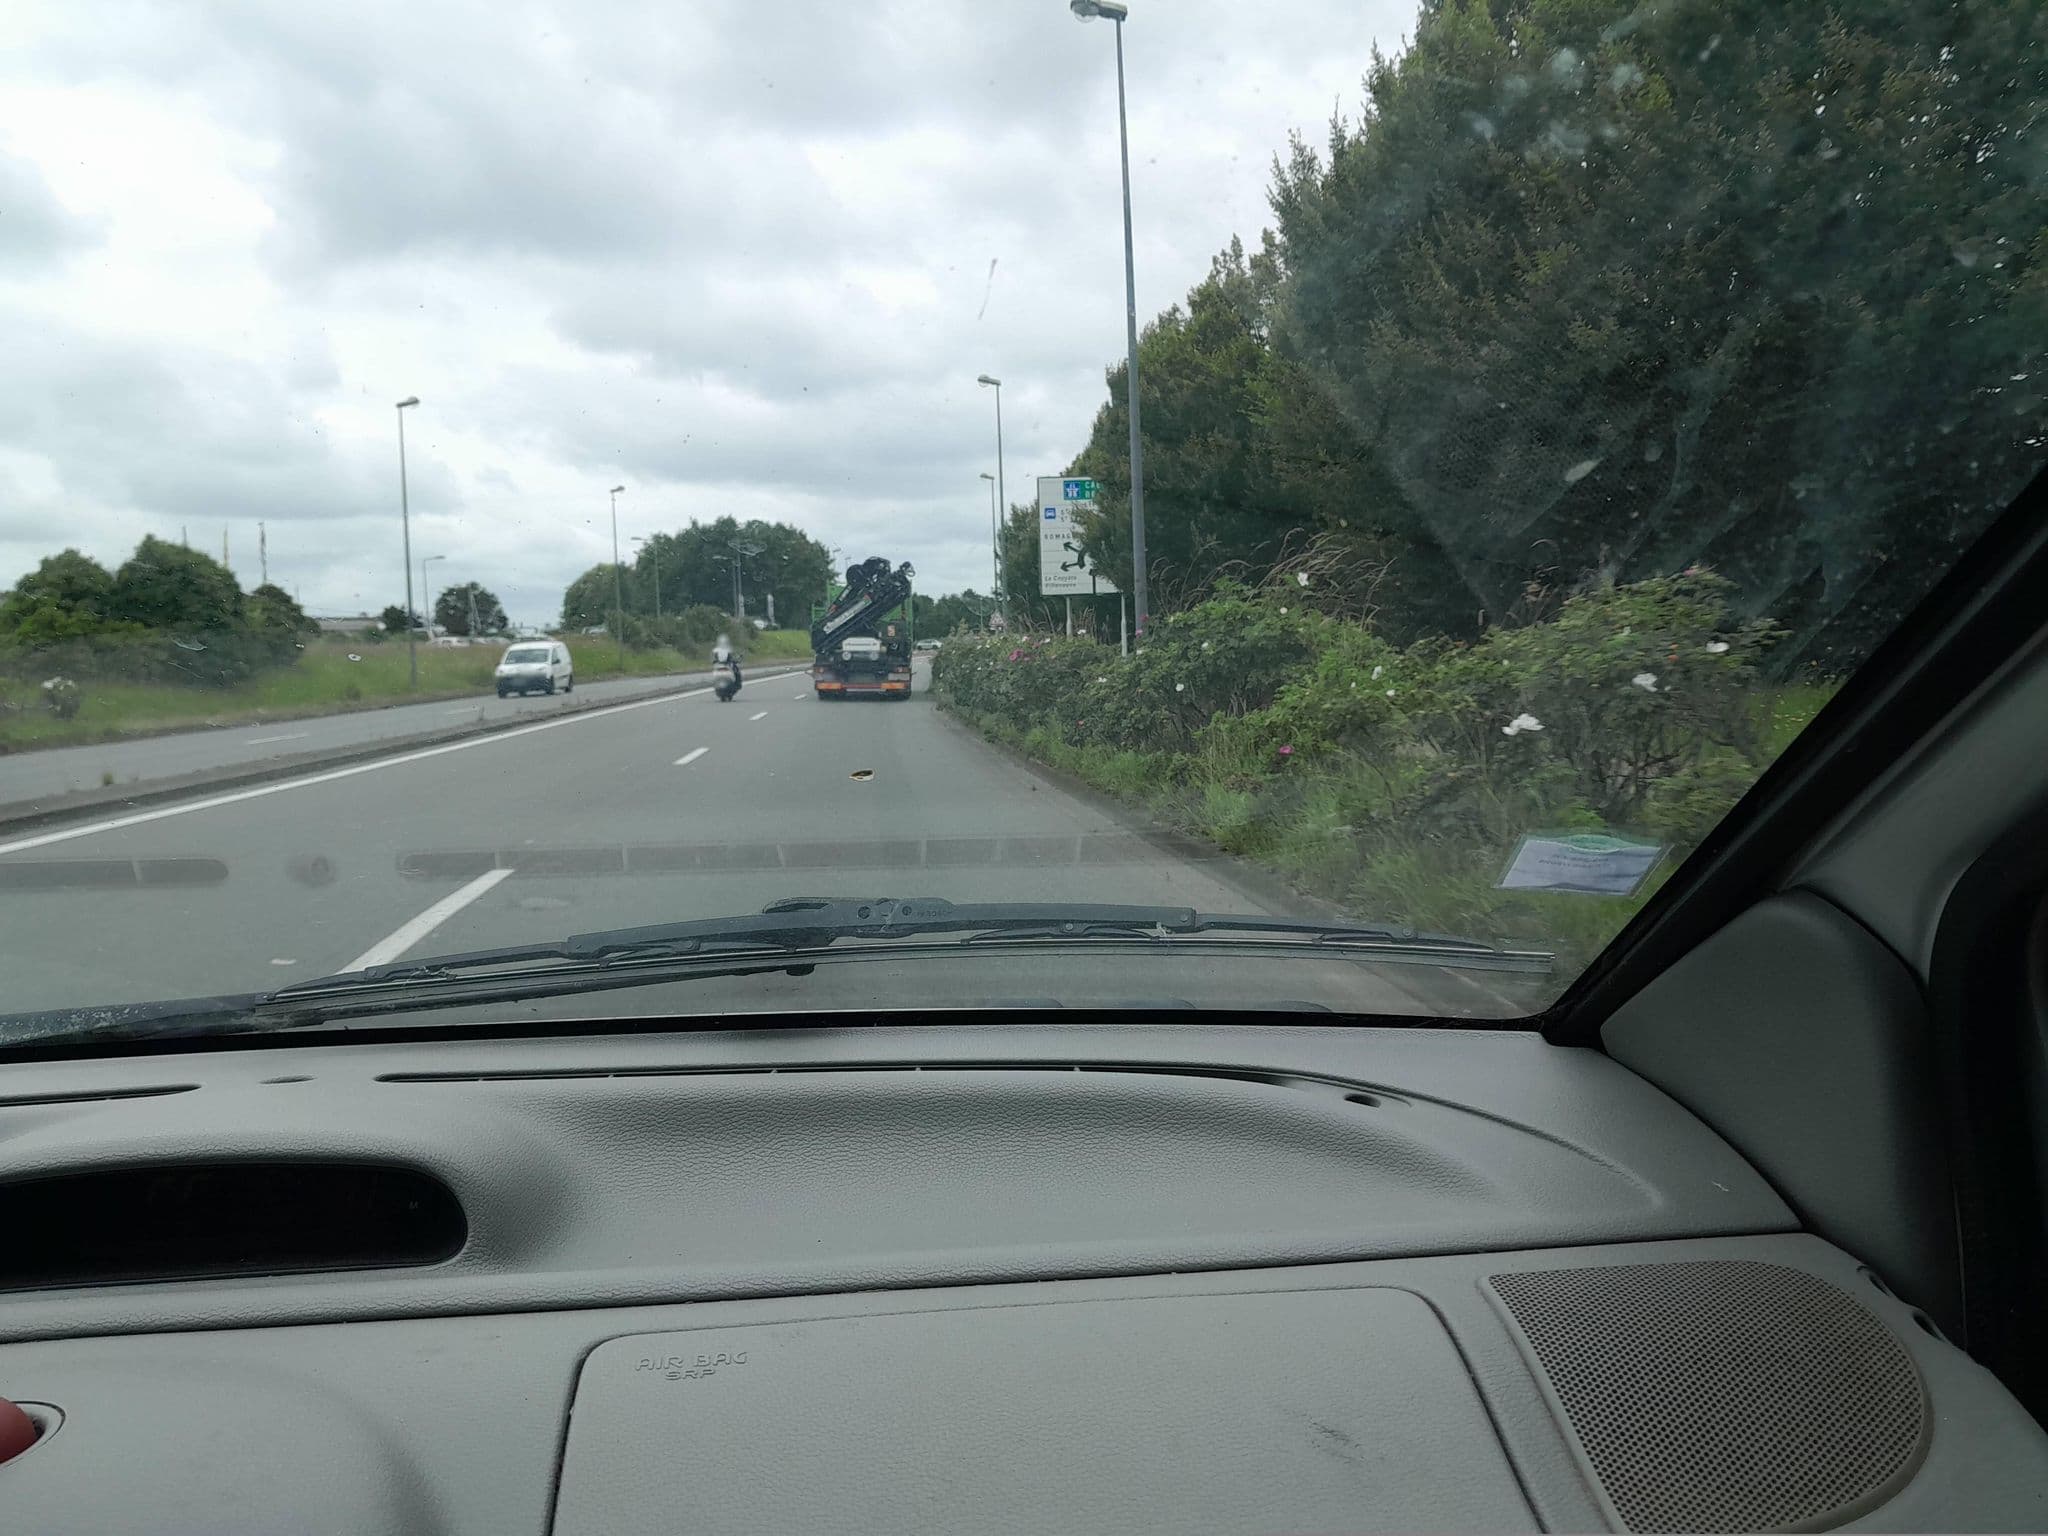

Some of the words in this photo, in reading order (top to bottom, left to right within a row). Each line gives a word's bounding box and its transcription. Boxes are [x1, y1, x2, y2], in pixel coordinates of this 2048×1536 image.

[635, 1355, 684, 1372] AIR
[693, 1351, 748, 1368] BAG
[664, 1368, 716, 1381] SRP
